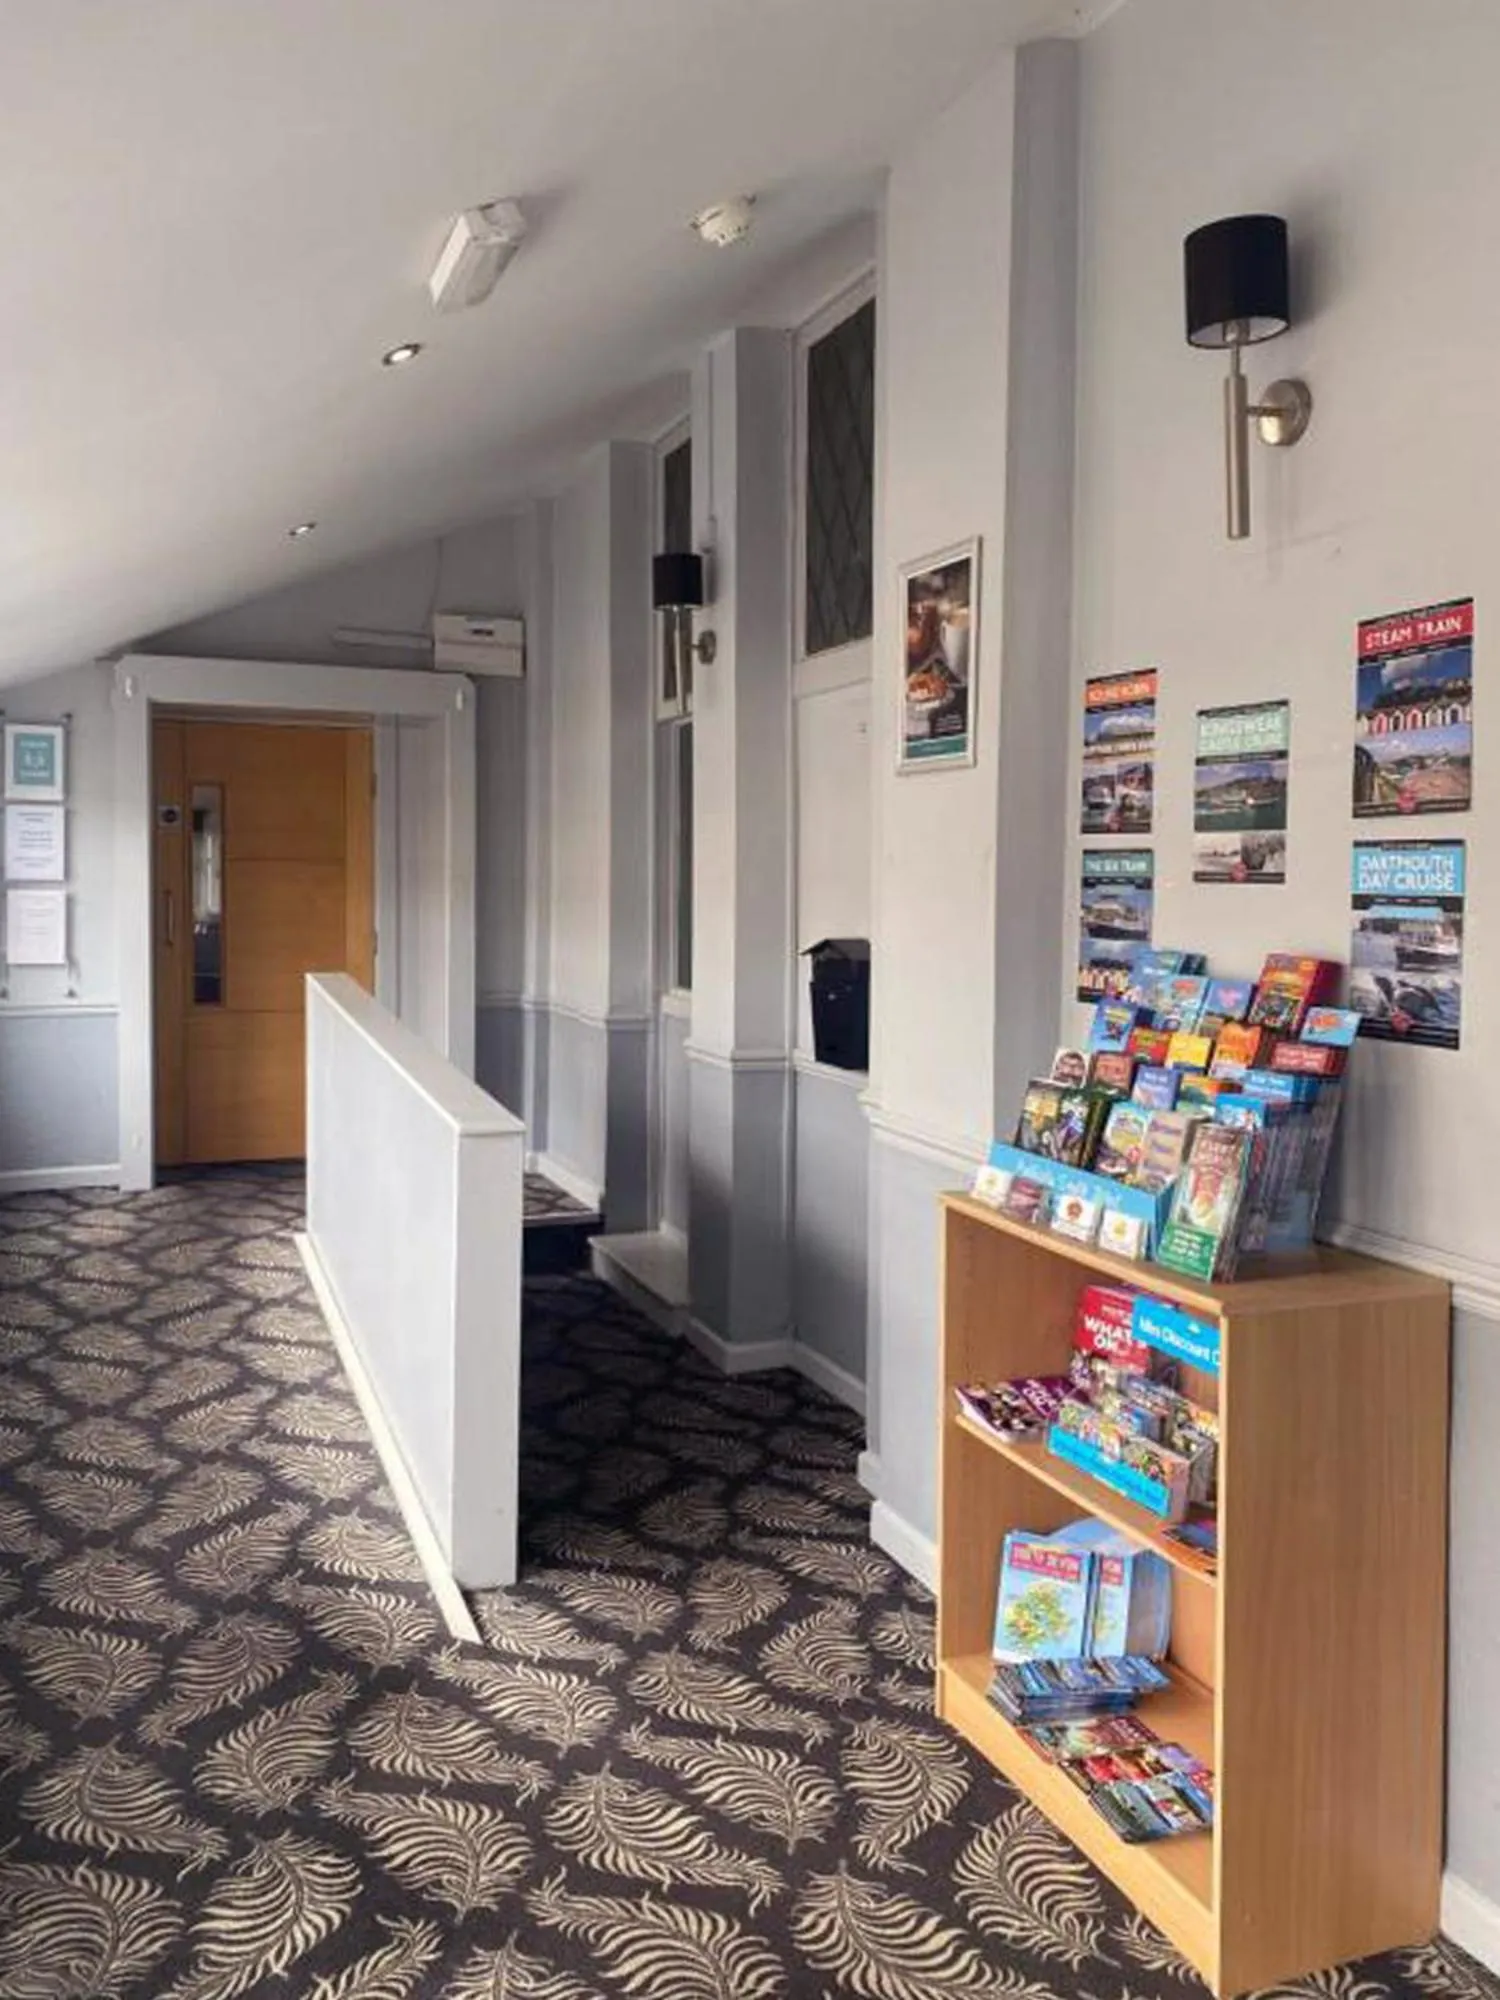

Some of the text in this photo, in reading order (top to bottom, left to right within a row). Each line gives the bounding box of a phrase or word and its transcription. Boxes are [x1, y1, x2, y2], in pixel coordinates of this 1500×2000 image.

[1365, 626, 1412, 649] STEAM
[1416, 615, 1463, 640] TRAIN
[1358, 855, 1455, 874] DARTMOUTH
[1359, 872, 1455, 892] DAY CRUISE
